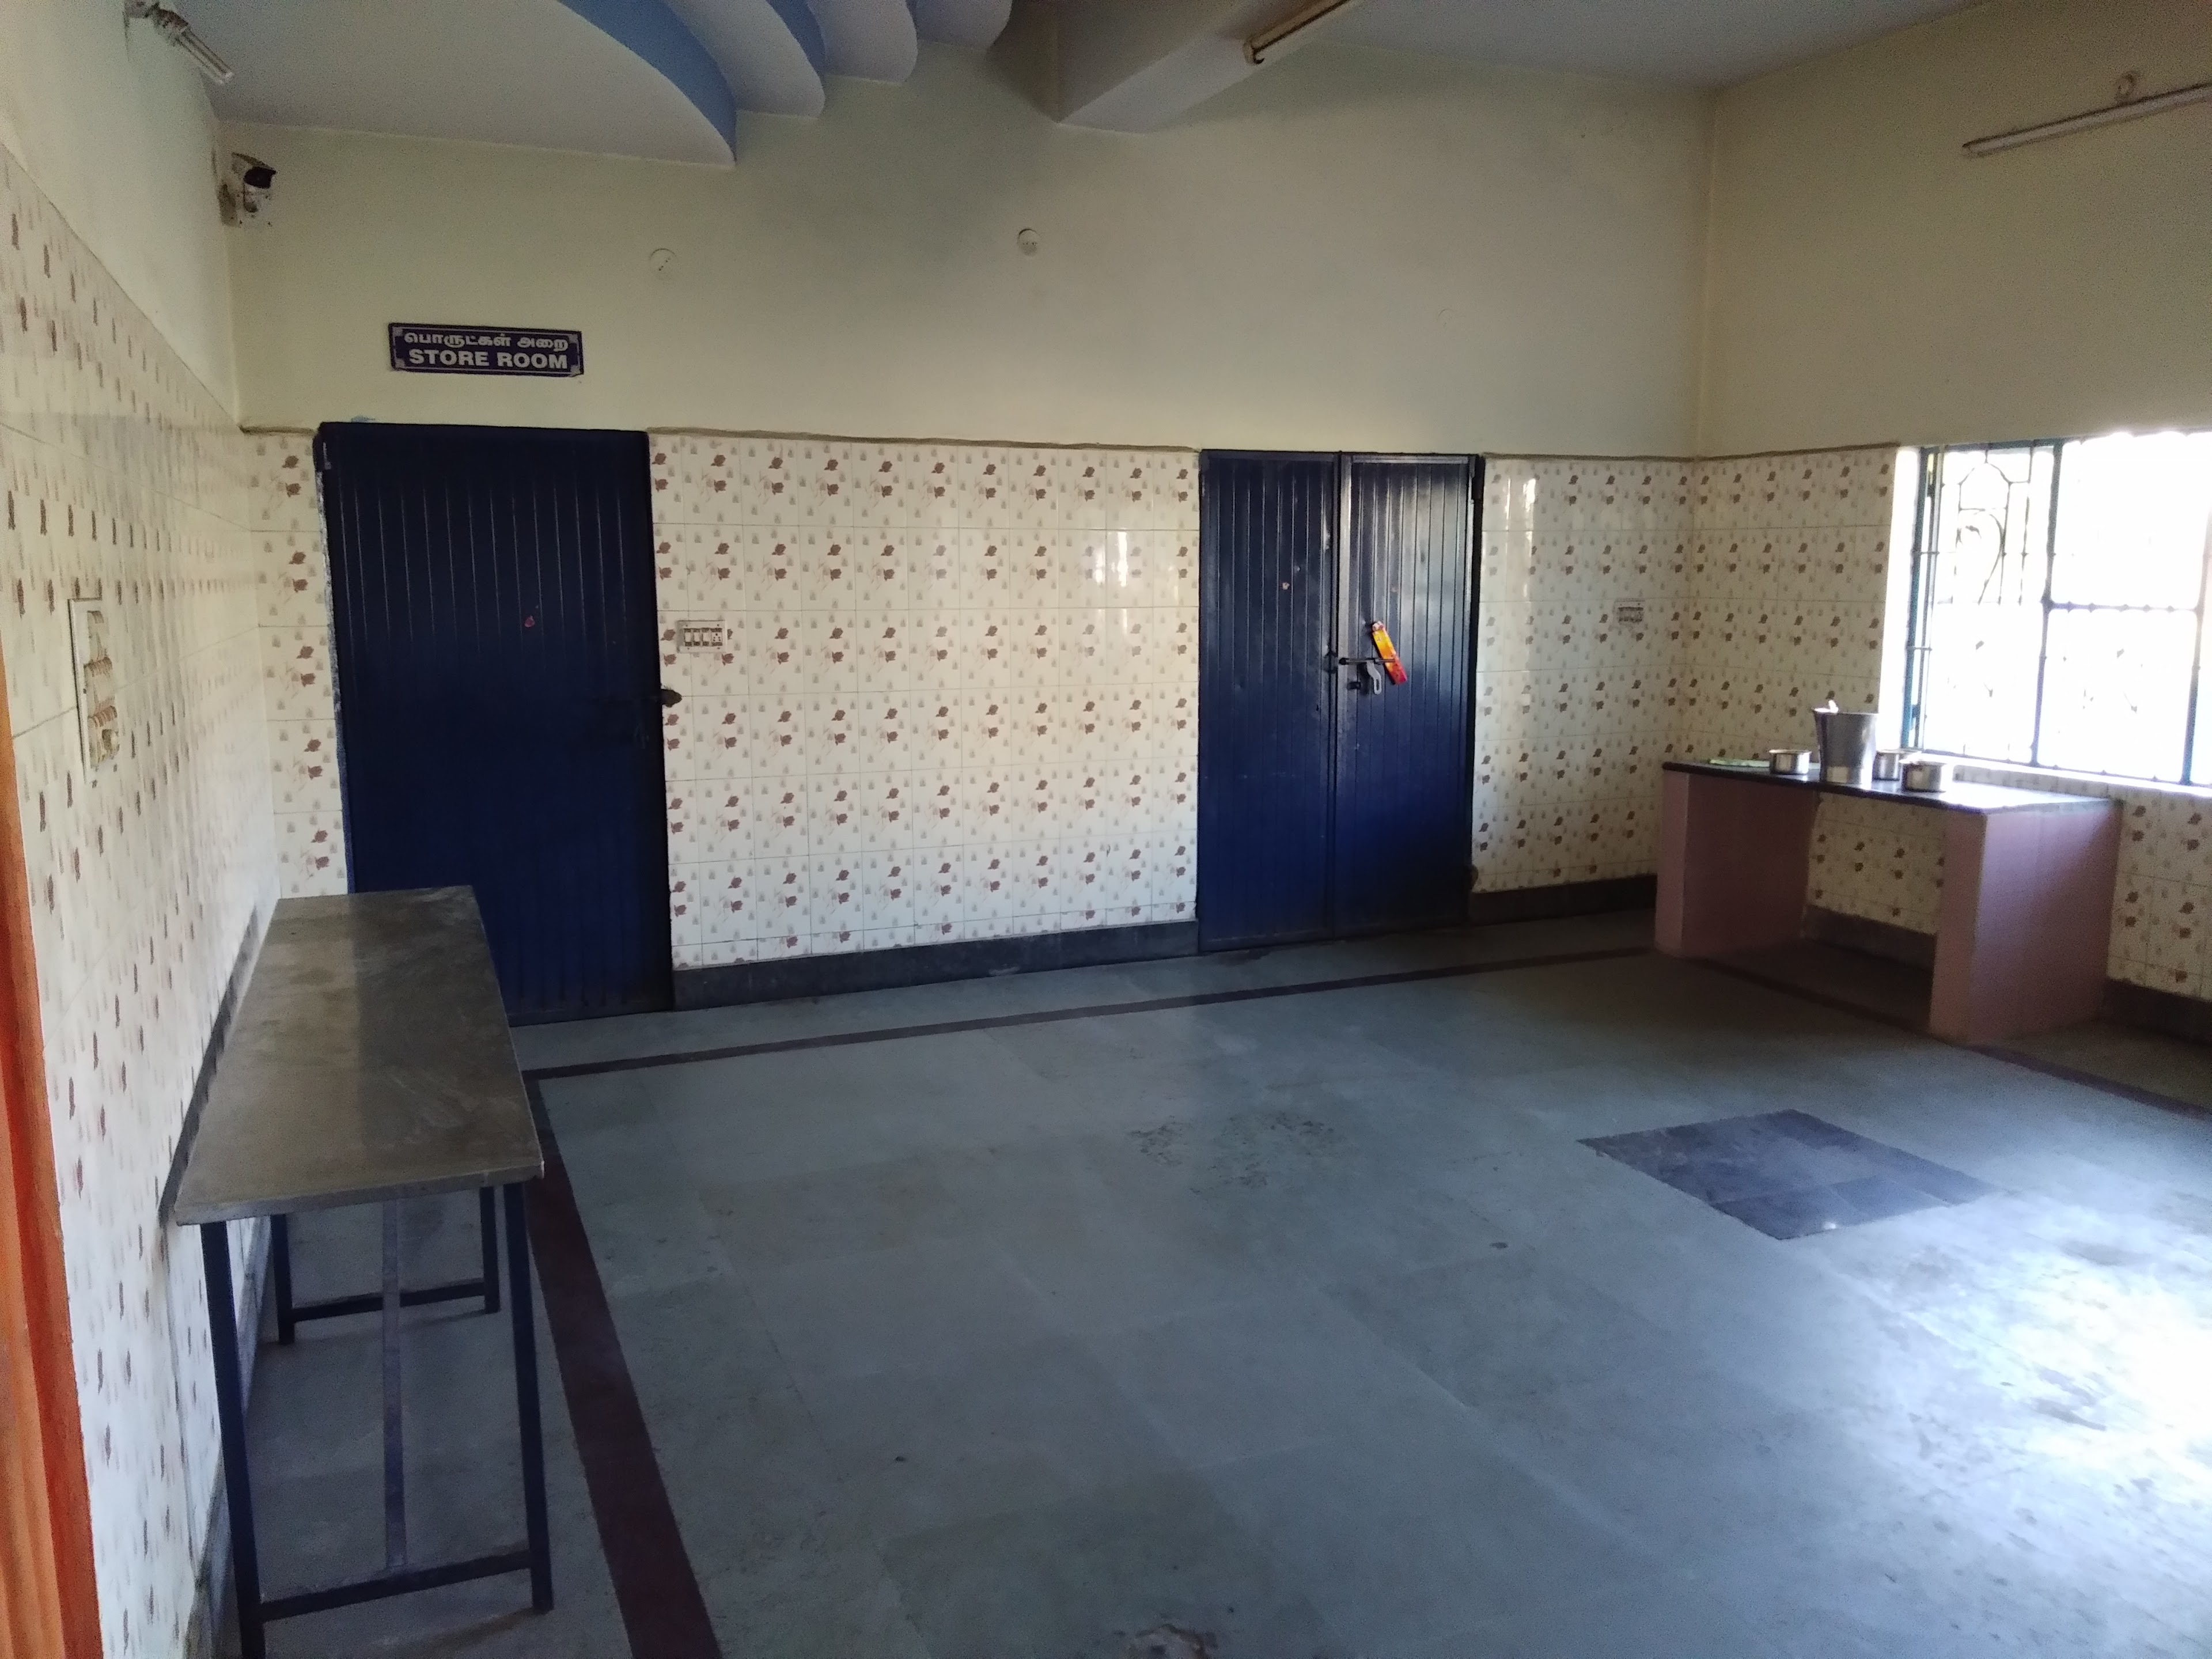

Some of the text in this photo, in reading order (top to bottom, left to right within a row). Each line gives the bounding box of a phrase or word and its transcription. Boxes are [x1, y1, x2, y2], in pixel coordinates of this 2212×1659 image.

[404, 333, 569, 352] பொருட்கள் அறை
[410, 349, 568, 369] STORE ROOM
